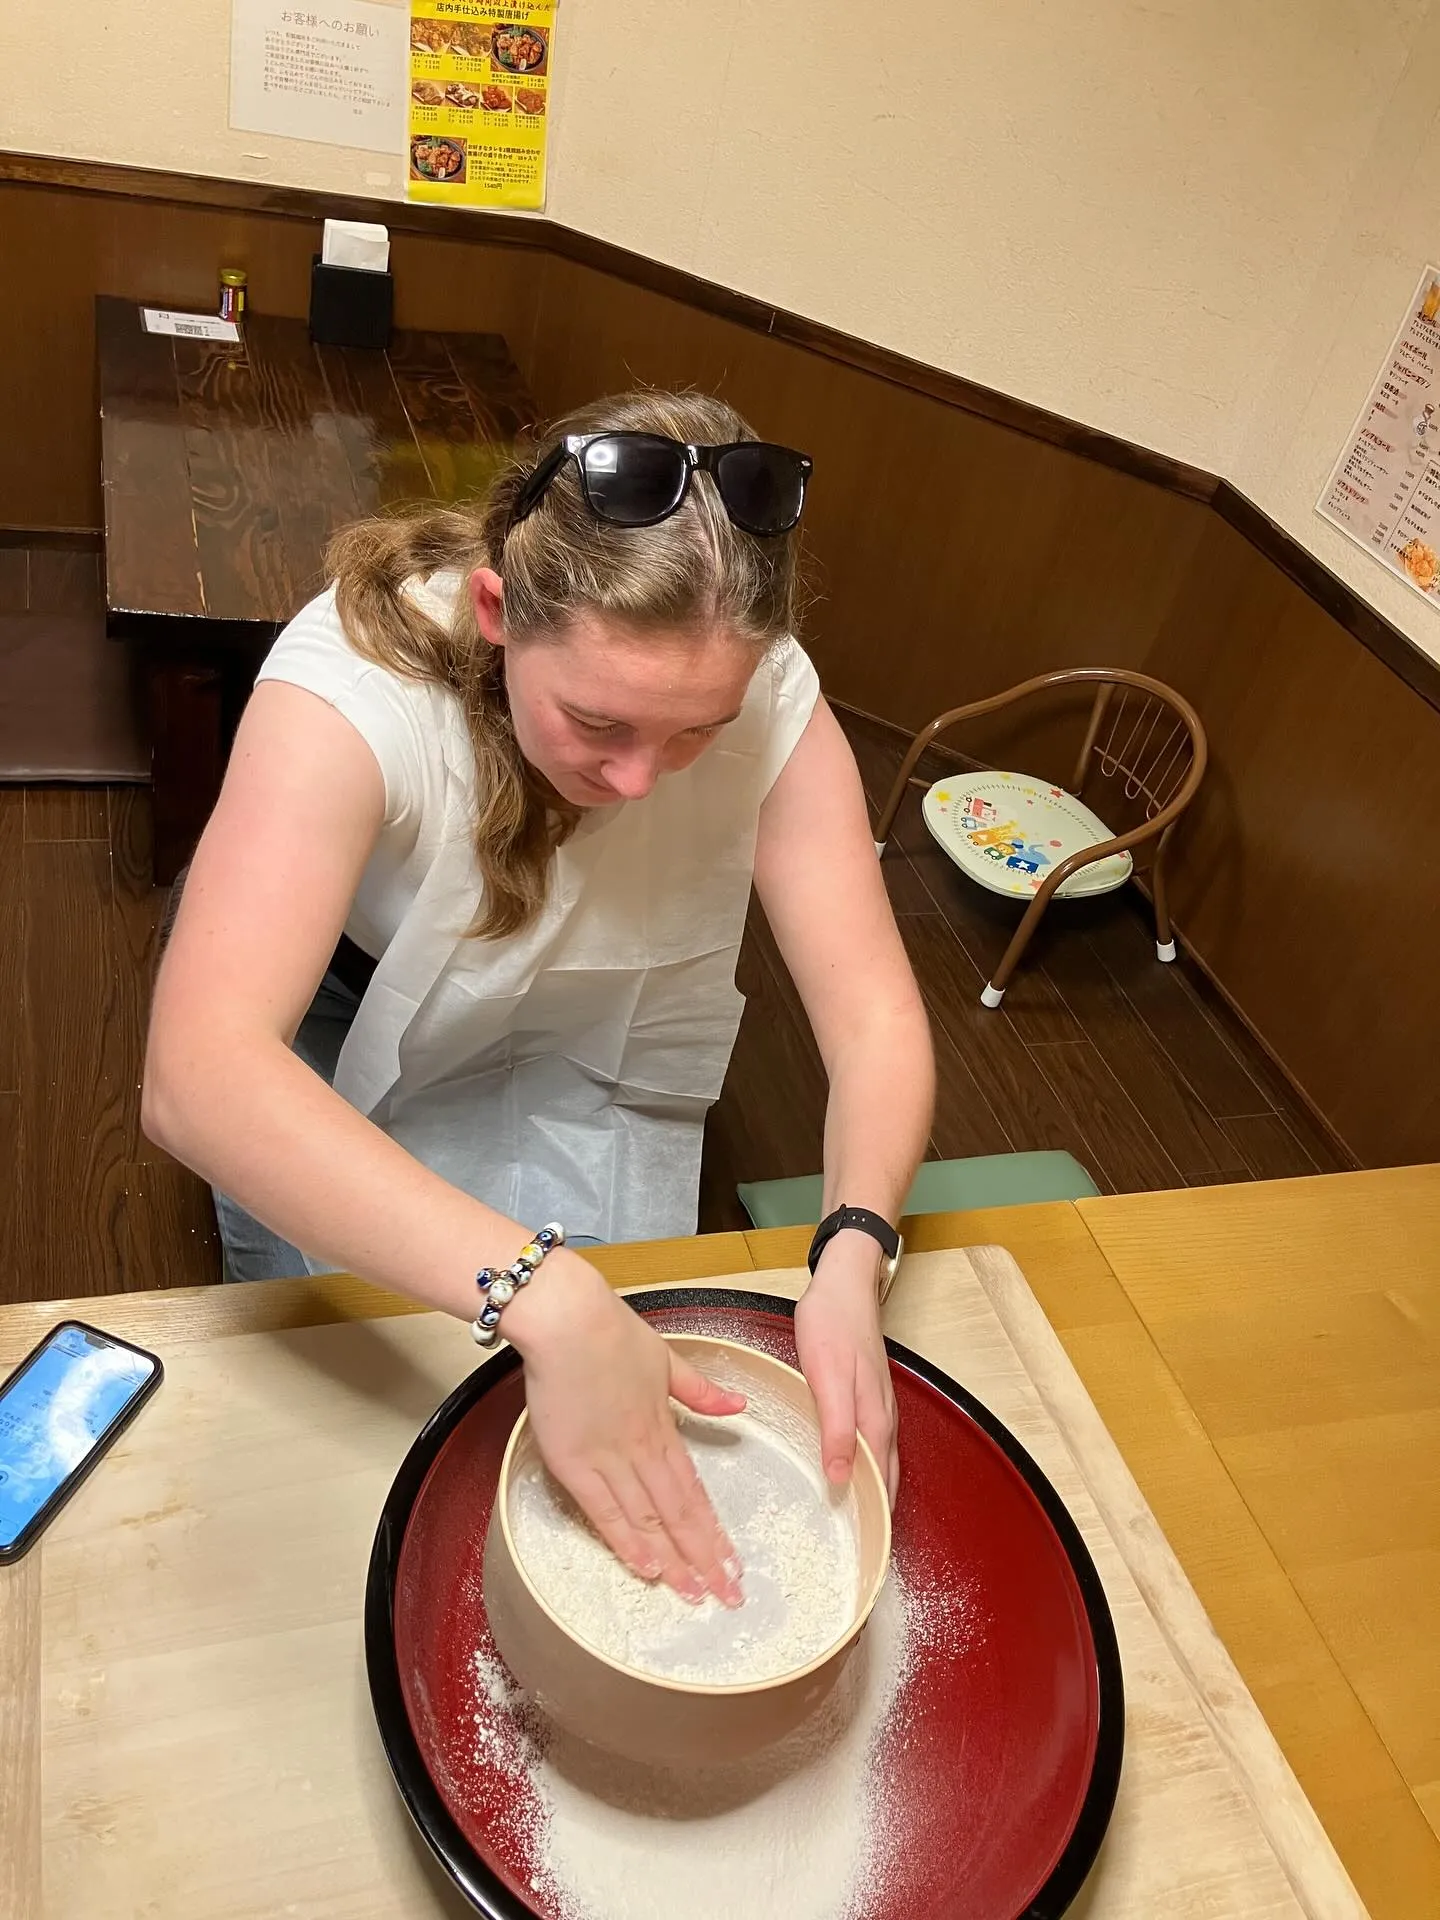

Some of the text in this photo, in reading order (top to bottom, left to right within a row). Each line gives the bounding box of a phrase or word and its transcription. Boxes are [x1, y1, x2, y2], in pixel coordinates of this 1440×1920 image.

[436, 3, 529, 20] 店内手仕込み特製唐揚げ
[281, 10, 380, 38] お客様へのお願い
